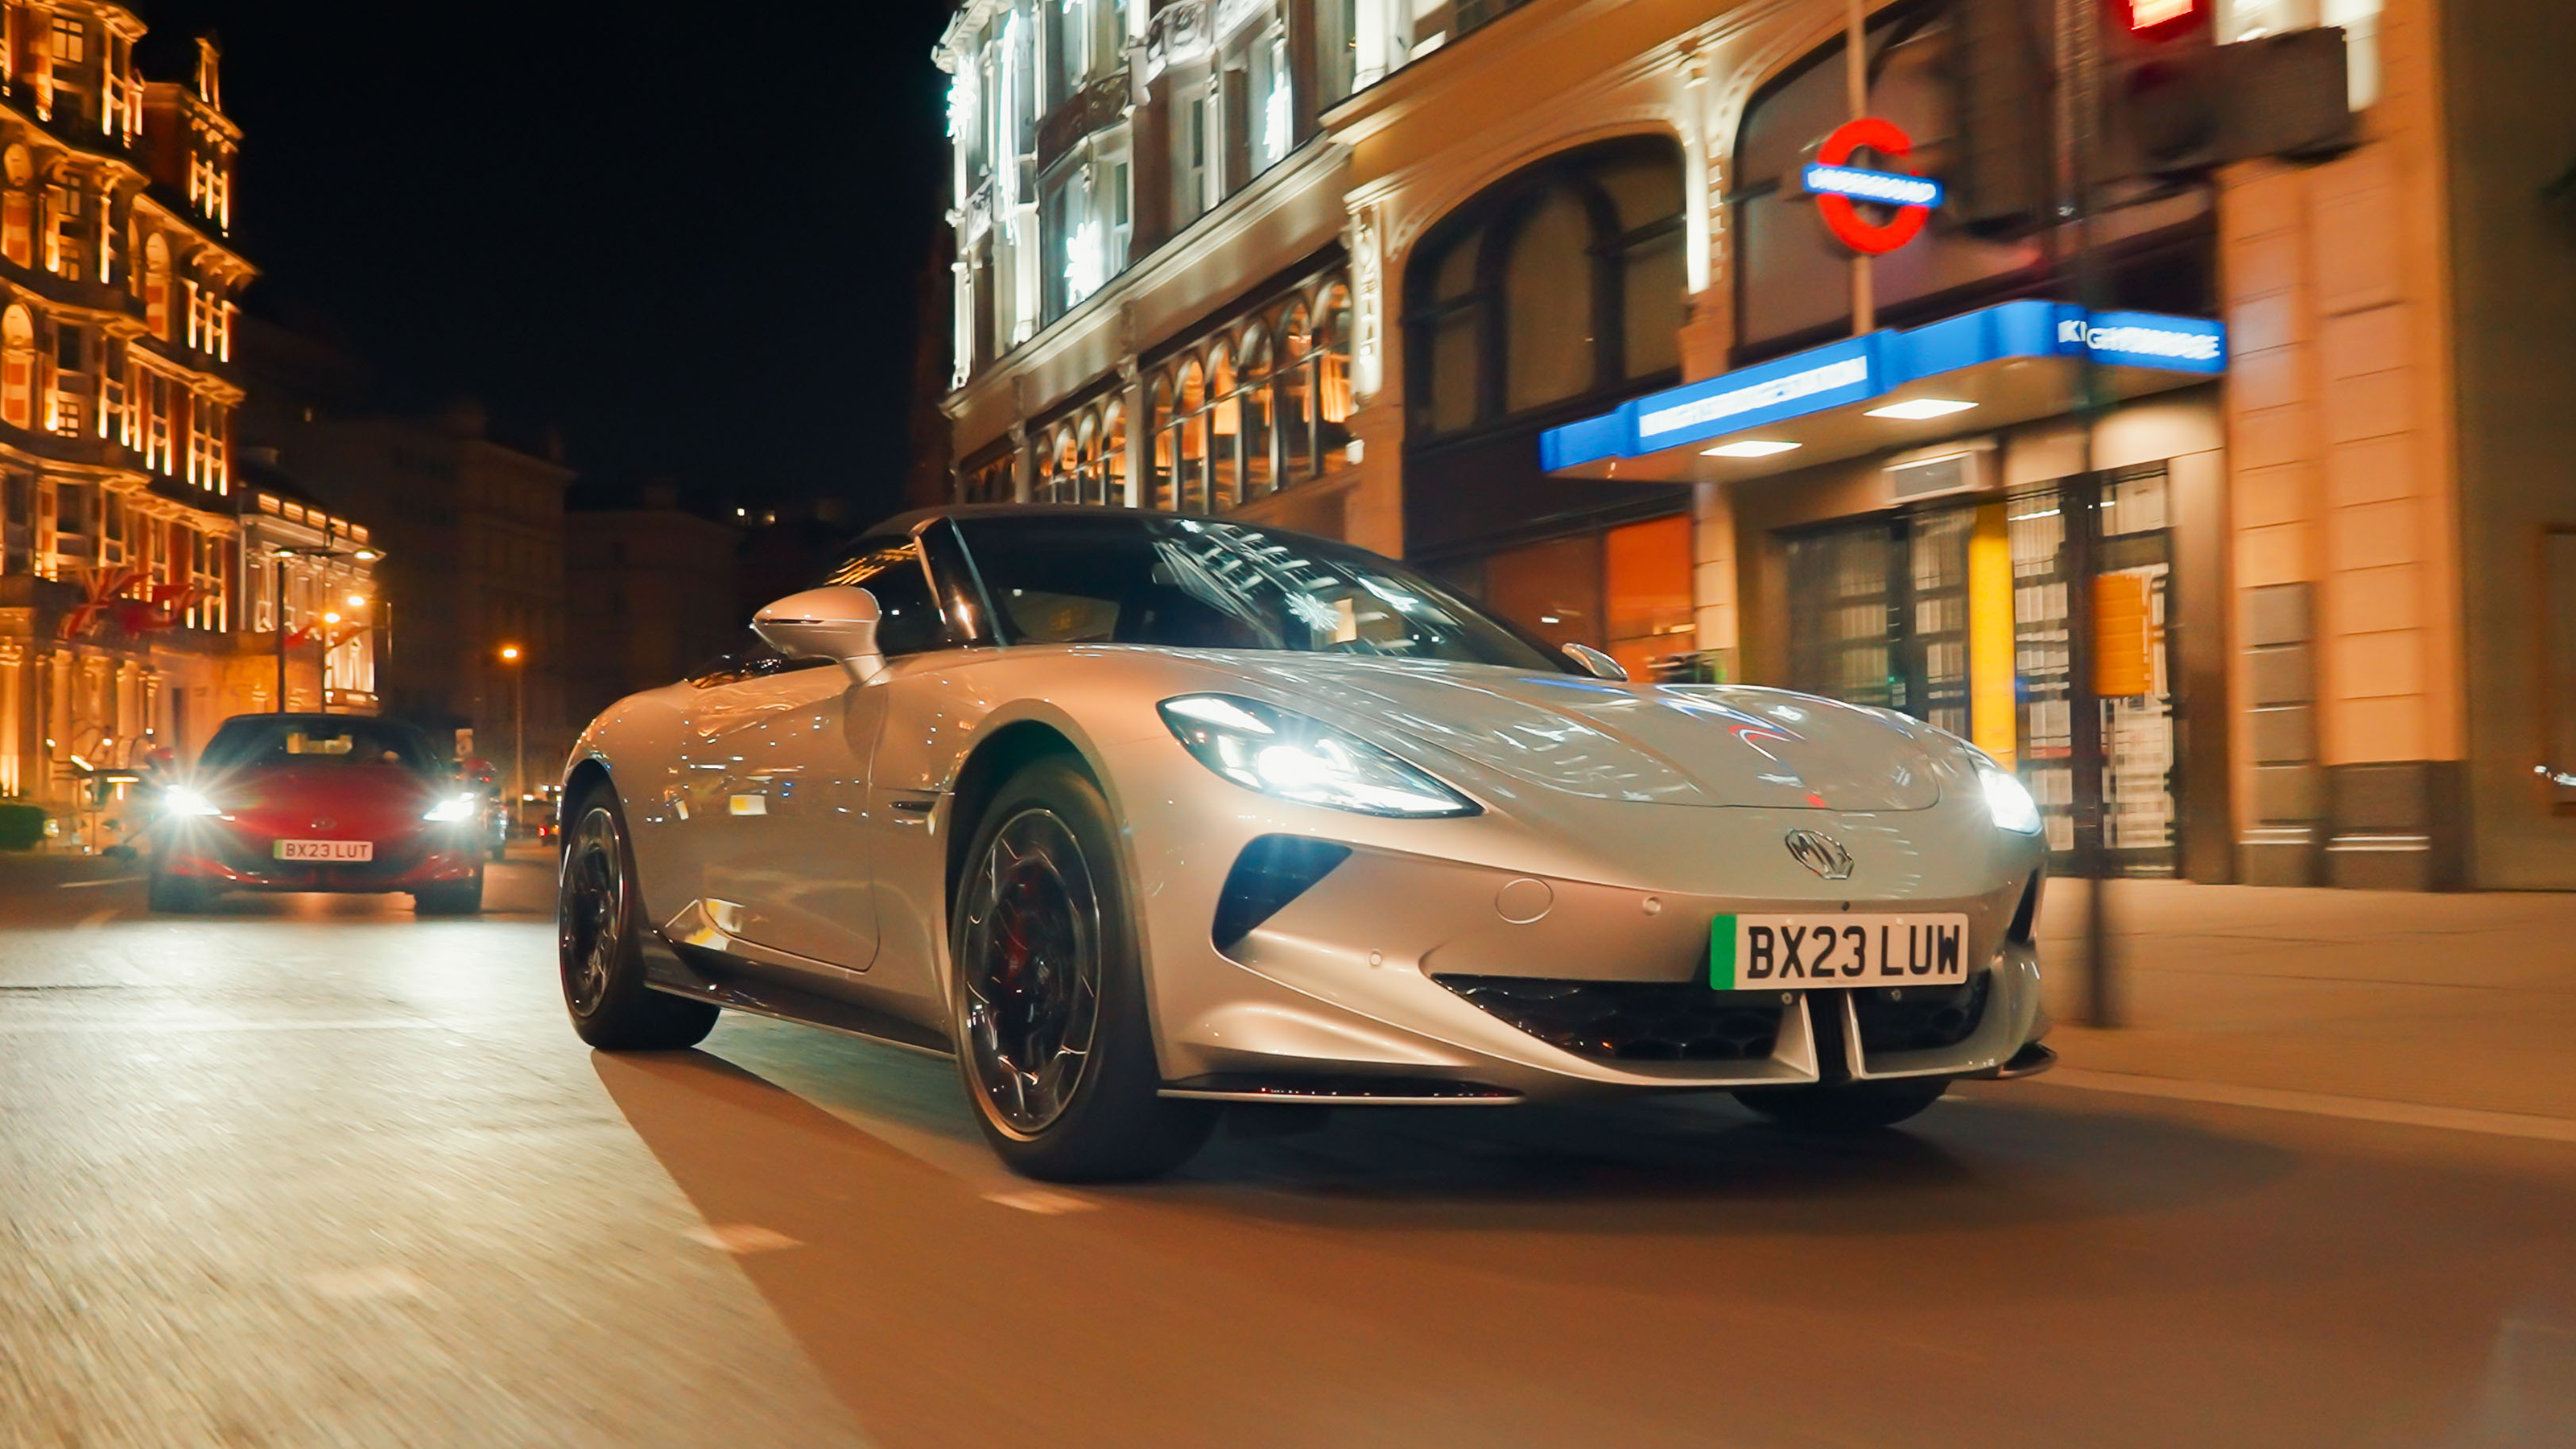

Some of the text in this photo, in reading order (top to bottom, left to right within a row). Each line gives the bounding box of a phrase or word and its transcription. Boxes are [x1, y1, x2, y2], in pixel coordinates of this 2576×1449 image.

[286, 843, 368, 858] BX23 LUT
[1747, 925, 1960, 979] BX23 LUW
